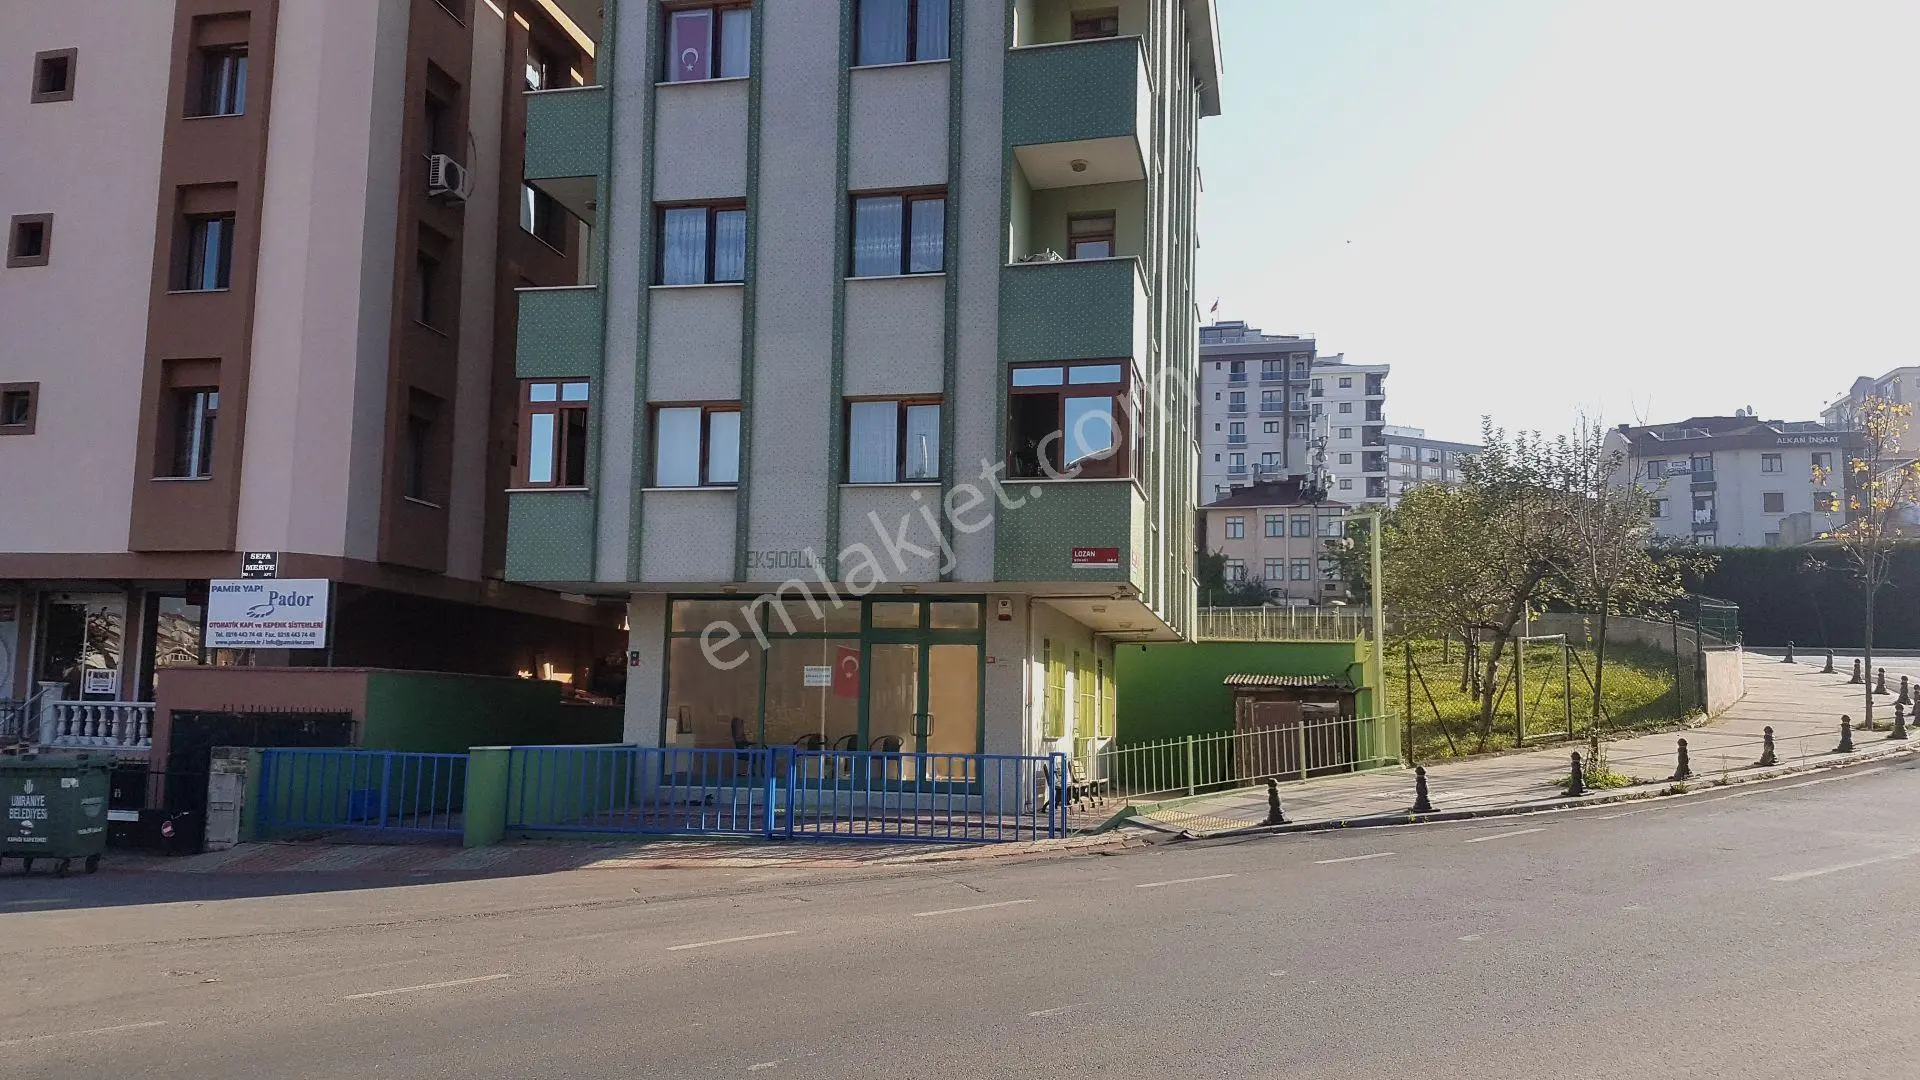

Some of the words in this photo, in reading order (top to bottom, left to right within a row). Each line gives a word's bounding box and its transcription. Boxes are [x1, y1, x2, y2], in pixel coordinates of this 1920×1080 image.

[1074, 550, 1096, 558] LOZAN
[211, 583, 241, 593] PAMİR
[243, 585, 264, 593] YAPI
[268, 590, 314, 607] Pador
